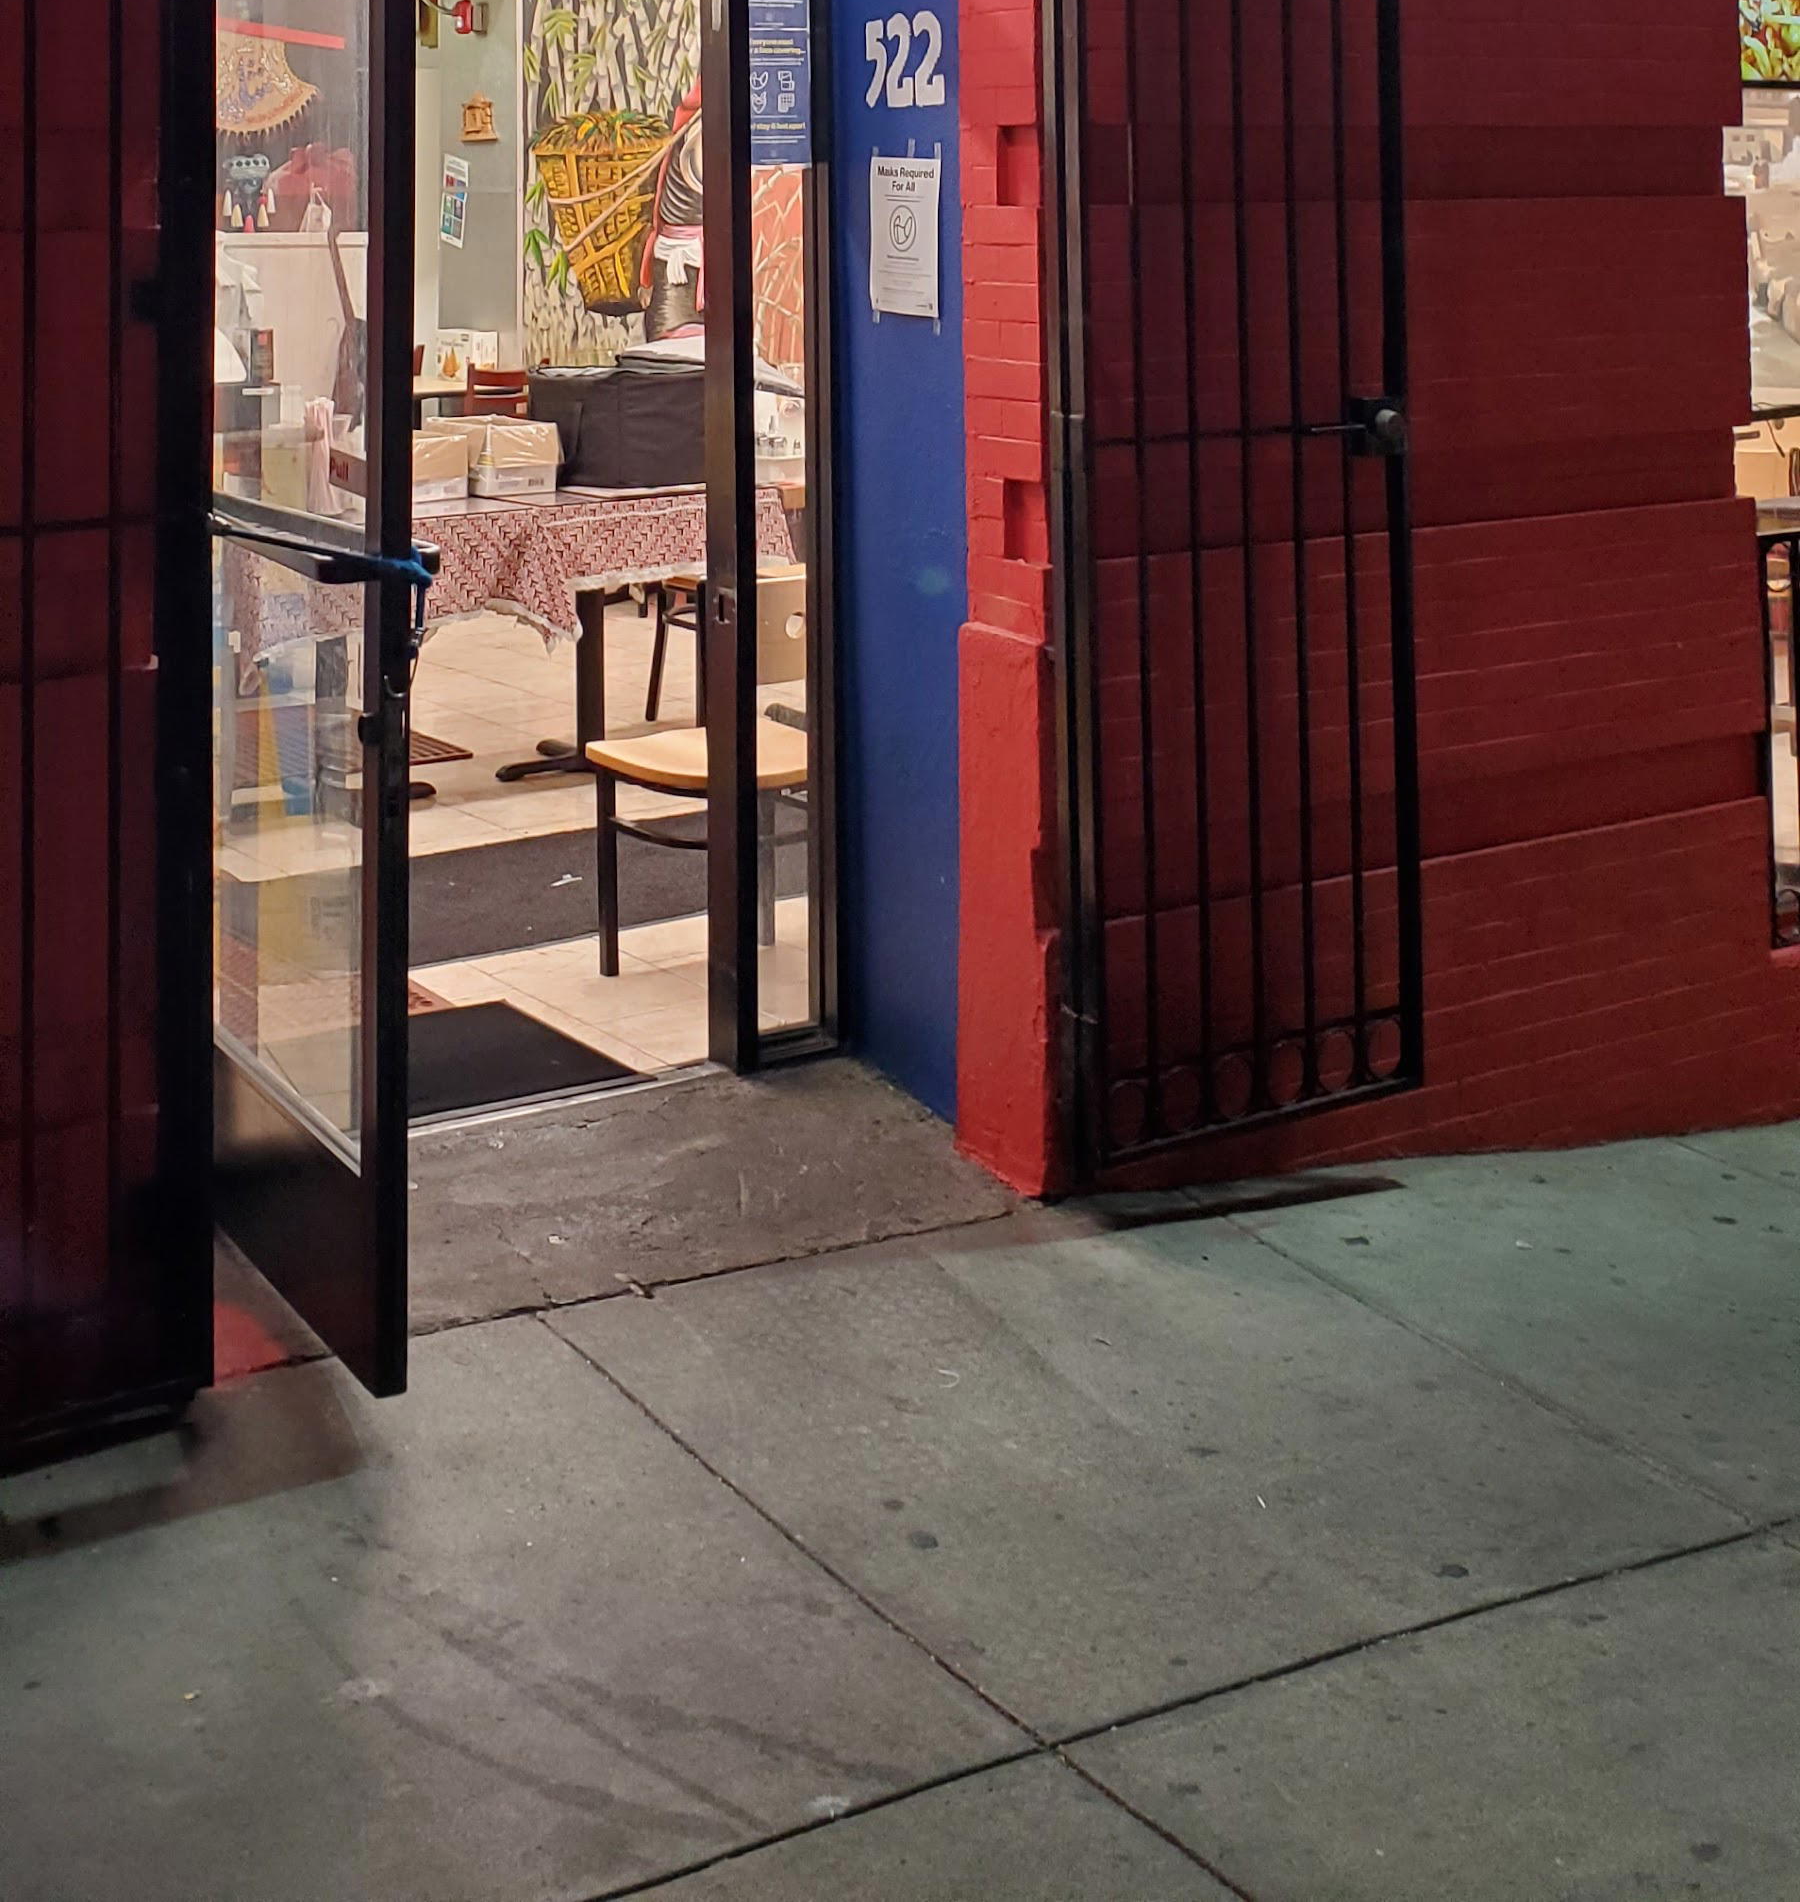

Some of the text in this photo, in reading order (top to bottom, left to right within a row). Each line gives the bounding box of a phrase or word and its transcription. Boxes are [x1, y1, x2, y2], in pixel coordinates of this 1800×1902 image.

[865, 10, 946, 109] 522
[899, 166, 935, 180] Required
[891, 180, 916, 192] For All
[329, 456, 349, 483] Pull
